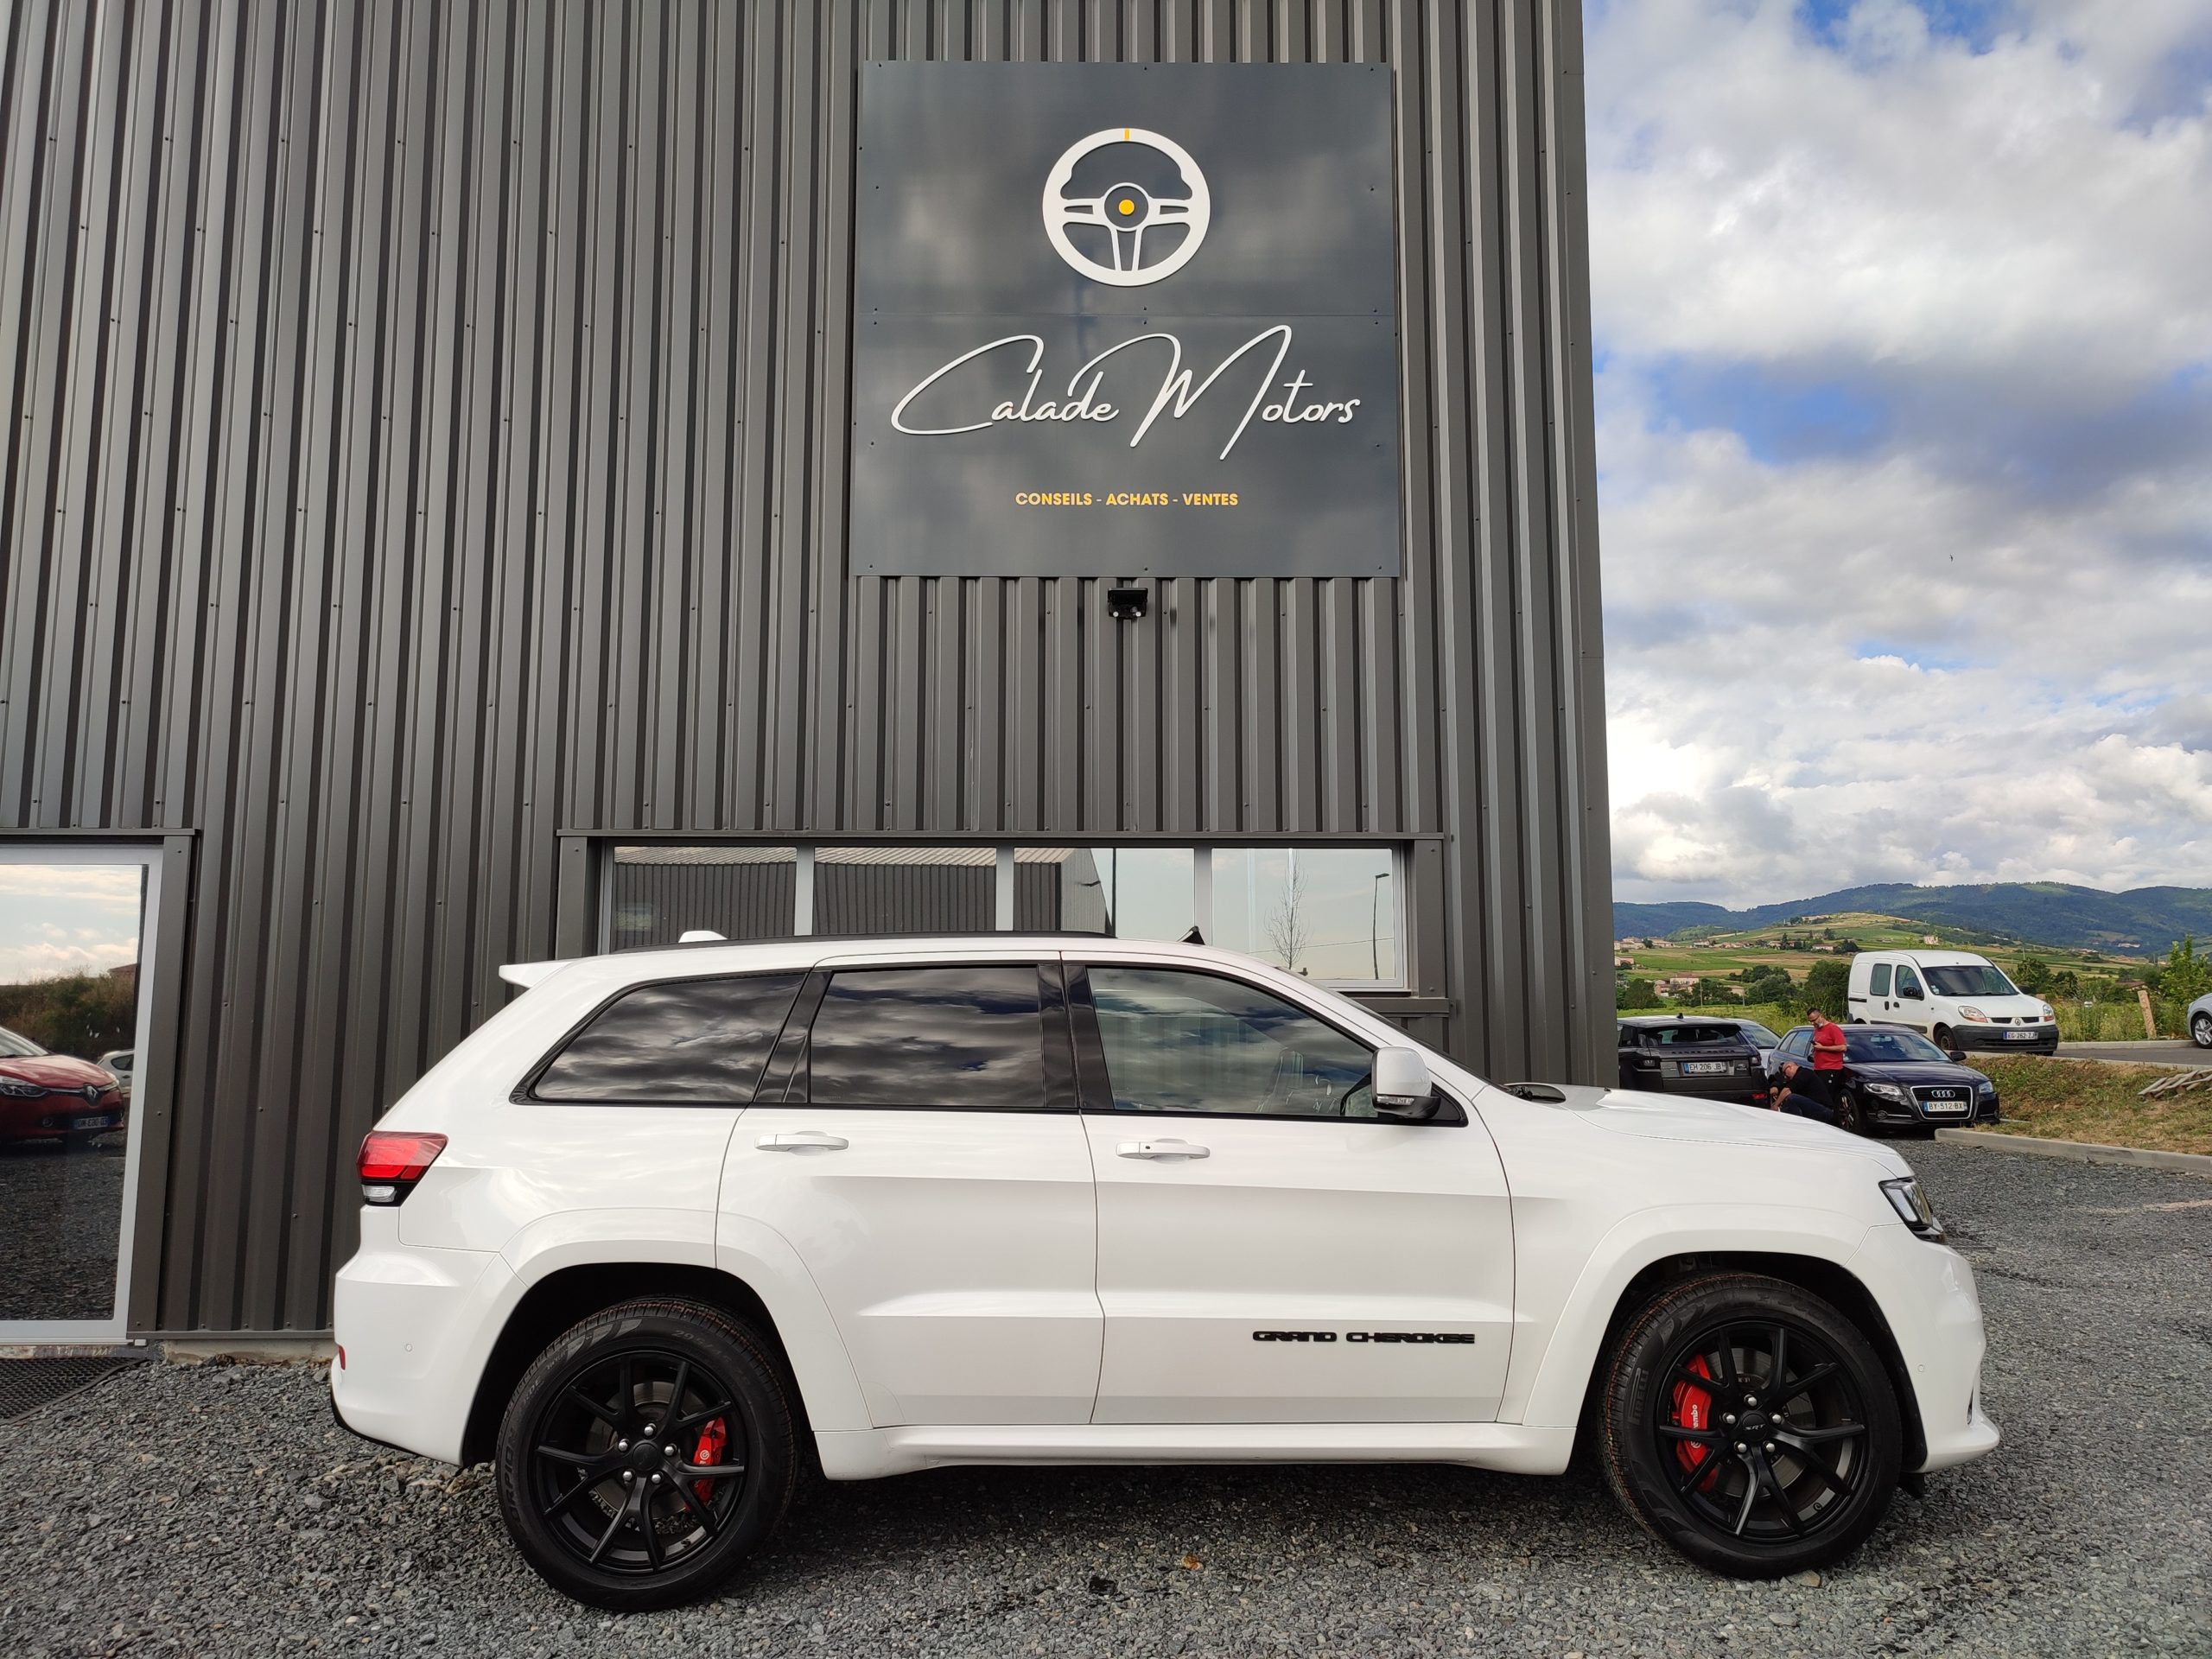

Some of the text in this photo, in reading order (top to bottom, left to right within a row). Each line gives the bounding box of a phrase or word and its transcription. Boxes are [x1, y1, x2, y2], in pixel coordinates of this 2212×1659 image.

[890, 324, 1361, 461] Calade Motors
[1015, 493, 1092, 505] CONSEILS
[1105, 493, 1169, 505] ACHATS
[1182, 493, 1238, 505] VENTES
[1253, 1331, 1475, 1344] GRAND CHEROKEE
